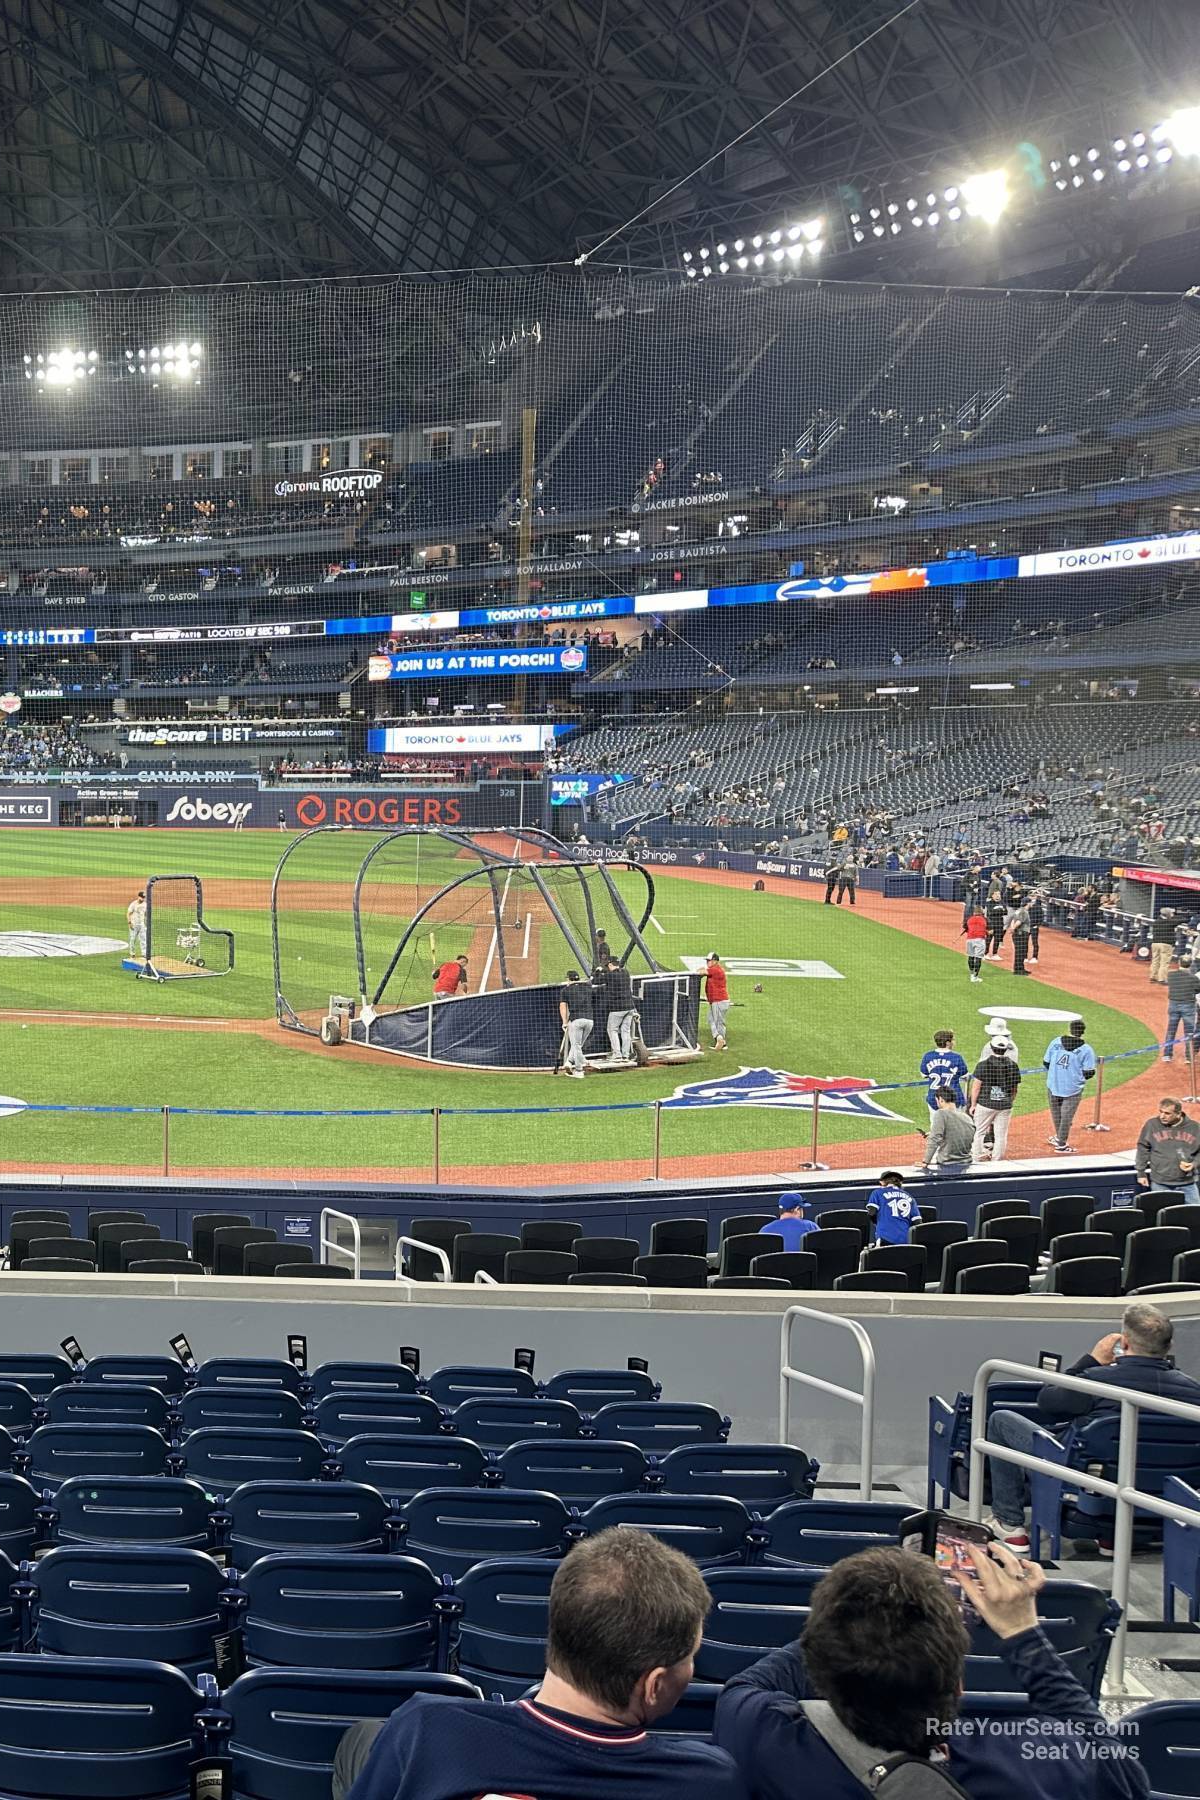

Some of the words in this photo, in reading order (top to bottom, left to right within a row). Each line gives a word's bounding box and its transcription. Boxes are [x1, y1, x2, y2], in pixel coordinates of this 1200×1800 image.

[275, 480, 320, 497] Corona
[322, 474, 382, 492] ROOFTOP
[338, 490, 365, 498] PATIO
[645, 499, 676, 511] JACKIE
[679, 491, 729, 507] ROBINSON
[651, 550, 675, 561] JOSE
[680, 545, 727, 559] BAUTISTA
[1057, 549, 1134, 568] TORONTO
[517, 567, 535, 575] ROY
[536, 560, 582, 574] HALLADAY
[389, 576, 408, 586] PAUL
[411, 573, 449, 585] BEESTON
[149, 593, 166, 602] CITO
[168, 592, 199, 601] GASTON
[268, 586, 282, 595] PAT
[283, 585, 315, 594] GILLICK
[44, 597, 63, 605] DAVE
[65, 596, 86, 604] STIEB
[487, 609, 538, 622] TORONTO
[551, 605, 577, 617] BLUE
[579, 602, 605, 615] JAYS
[207, 629, 245, 637] LOCATED
[257, 627, 273, 636] SEC
[396, 659, 423, 672] JOIN
[426, 658, 443, 670] US
[448, 657, 466, 669] AT
[469, 656, 495, 668] THE
[499, 653, 554, 667] PORCH!
[128, 728, 208, 742] theScore
[222, 727, 252, 742] BET
[405, 735, 454, 745] TORONTO
[467, 735, 492, 744] BLUE
[496, 734, 522, 743] JAYS
[137, 771, 200, 783] CANADA
[205, 771, 235, 783] DRY
[499, 788, 516, 797] 328
[552, 781, 573, 791] MAY
[19, 804, 43, 814] KEG
[167, 796, 252, 824] Sobeys
[335, 798, 461, 824] ROGERS
[572, 846, 602, 858] Official
[641, 850, 677, 862] Shingle
[757, 861, 786, 872] theScore
[790, 864, 802, 875] BET
[1056, 1054, 1070, 1069] 4
[929, 1073, 953, 1090] 27
[888, 1199, 911, 1217] 19
